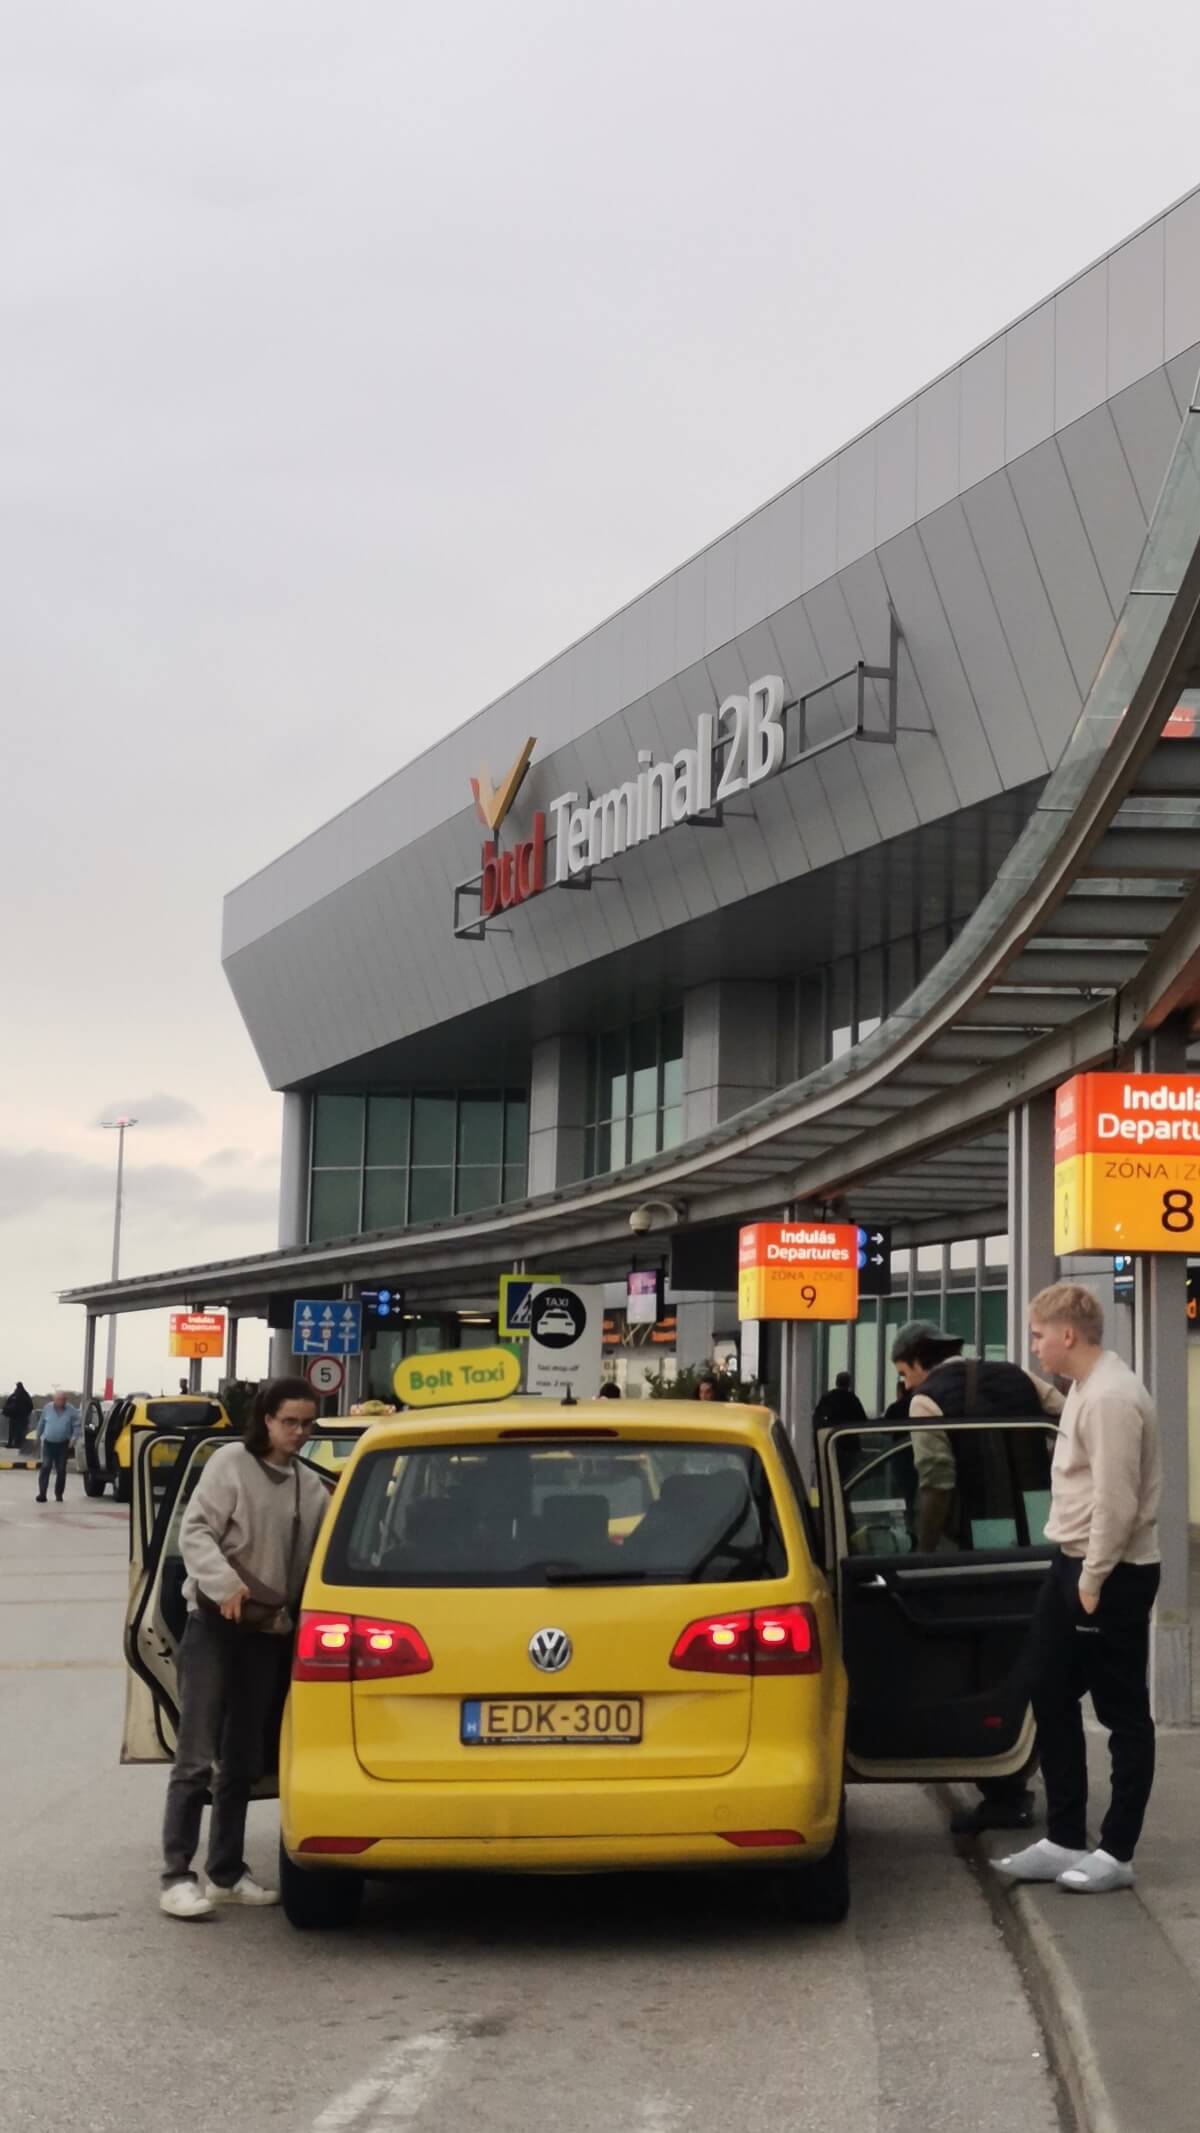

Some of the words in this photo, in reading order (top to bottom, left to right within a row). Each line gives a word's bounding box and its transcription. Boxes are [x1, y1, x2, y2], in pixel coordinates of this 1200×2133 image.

[481, 810, 545, 916] bud
[550, 713, 713, 881] Terminal
[716, 674, 785, 799] 2B
[1105, 1158, 1169, 1179] ZÓNA
[1161, 1189, 1195, 1233] 8
[780, 1229, 837, 1245] Indulás
[767, 1244, 850, 1261] Departures
[545, 1296, 569, 1308] TAXI
[800, 1284, 817, 1309] 9
[194, 1342, 209, 1354] 10
[320, 1367, 332, 1383] 5
[410, 1369, 453, 1390] Bolt
[459, 1361, 505, 1384] Taxi
[488, 1704, 632, 1733] EDK-300
